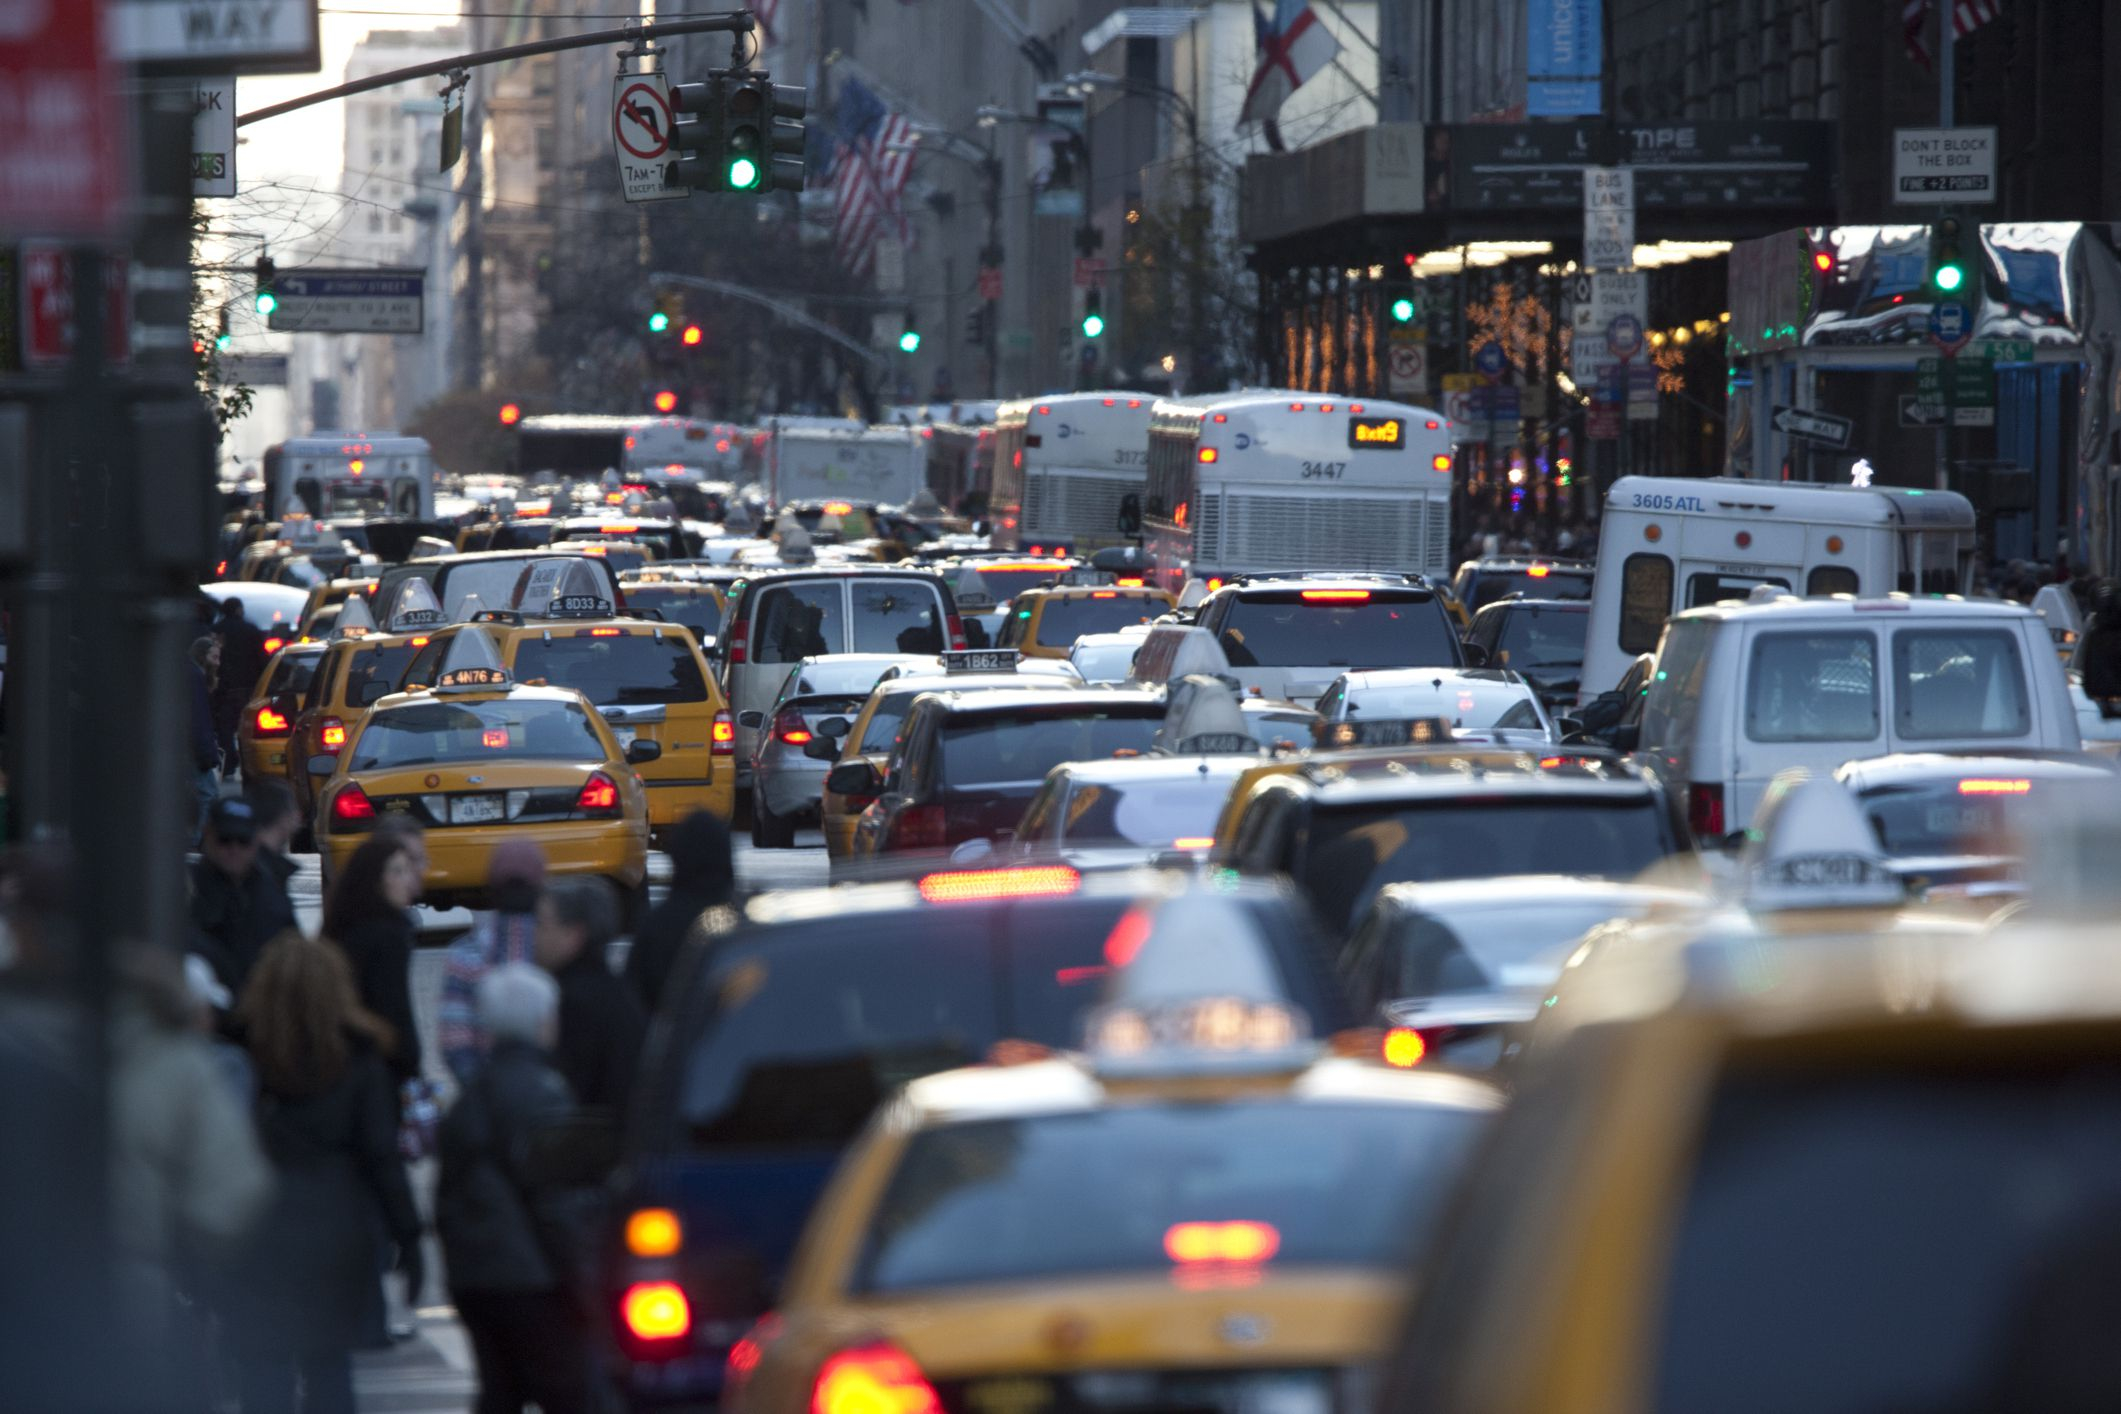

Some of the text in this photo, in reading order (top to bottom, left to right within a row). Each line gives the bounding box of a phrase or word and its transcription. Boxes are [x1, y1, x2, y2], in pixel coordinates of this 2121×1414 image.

[179, 0, 284, 41] WAY
[1546, 0, 1571, 63] unice
[1902, 139, 1988, 152] DON'T BLOCK
[1918, 154, 1972, 166] THE BOX
[625, 163, 665, 181] 7AM-7
[1595, 174, 1622, 188] BUS
[1949, 175, 1987, 190] POINTS
[1592, 192, 1625, 207] LANE
[1599, 276, 1639, 289] BUSES
[1601, 292, 1636, 305] ONLY
[1993, 342, 2016, 361] 56
[1301, 462, 1346, 479] 3447
[565, 598, 595, 610] 8D33
[408, 612, 433, 623] 3J32
[964, 654, 999, 668] 1B62
[456, 669, 489, 683] 4N76
